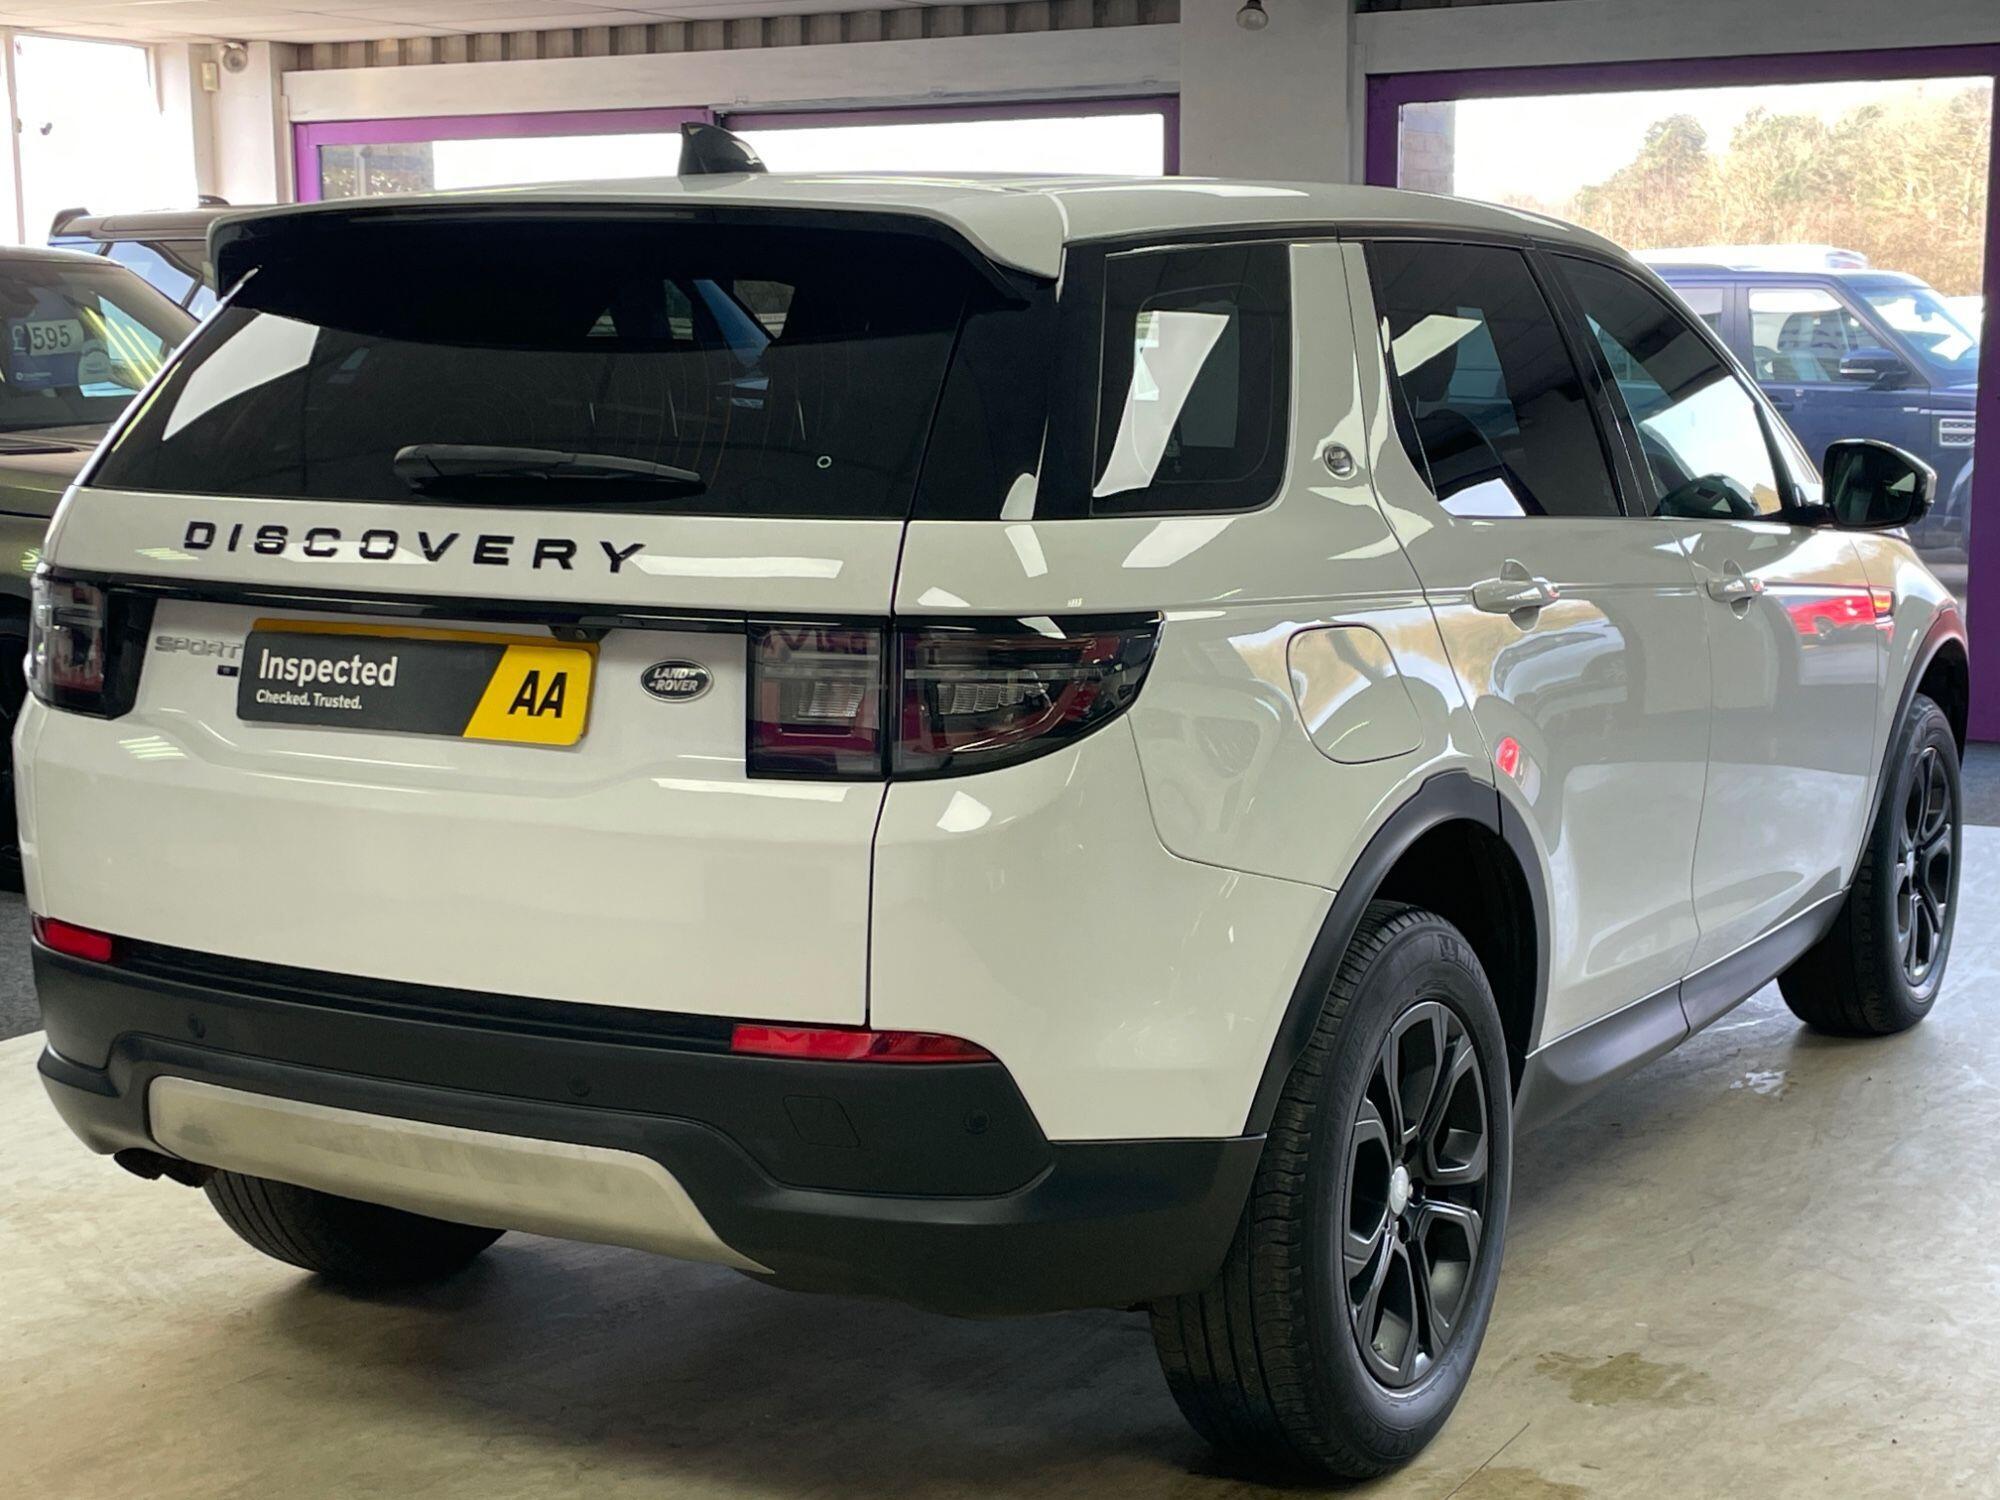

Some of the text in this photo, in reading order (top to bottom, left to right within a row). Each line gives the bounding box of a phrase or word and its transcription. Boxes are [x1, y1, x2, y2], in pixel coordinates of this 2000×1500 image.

[183, 521, 646, 574] DISCOVERY
[154, 635, 243, 660] SPORT
[259, 648, 398, 687] Inspected
[653, 667, 690, 679] LAND
[507, 670, 568, 718] AA
[655, 679, 699, 692] ROVER
[256, 688, 363, 710] Checked. Trusted.
